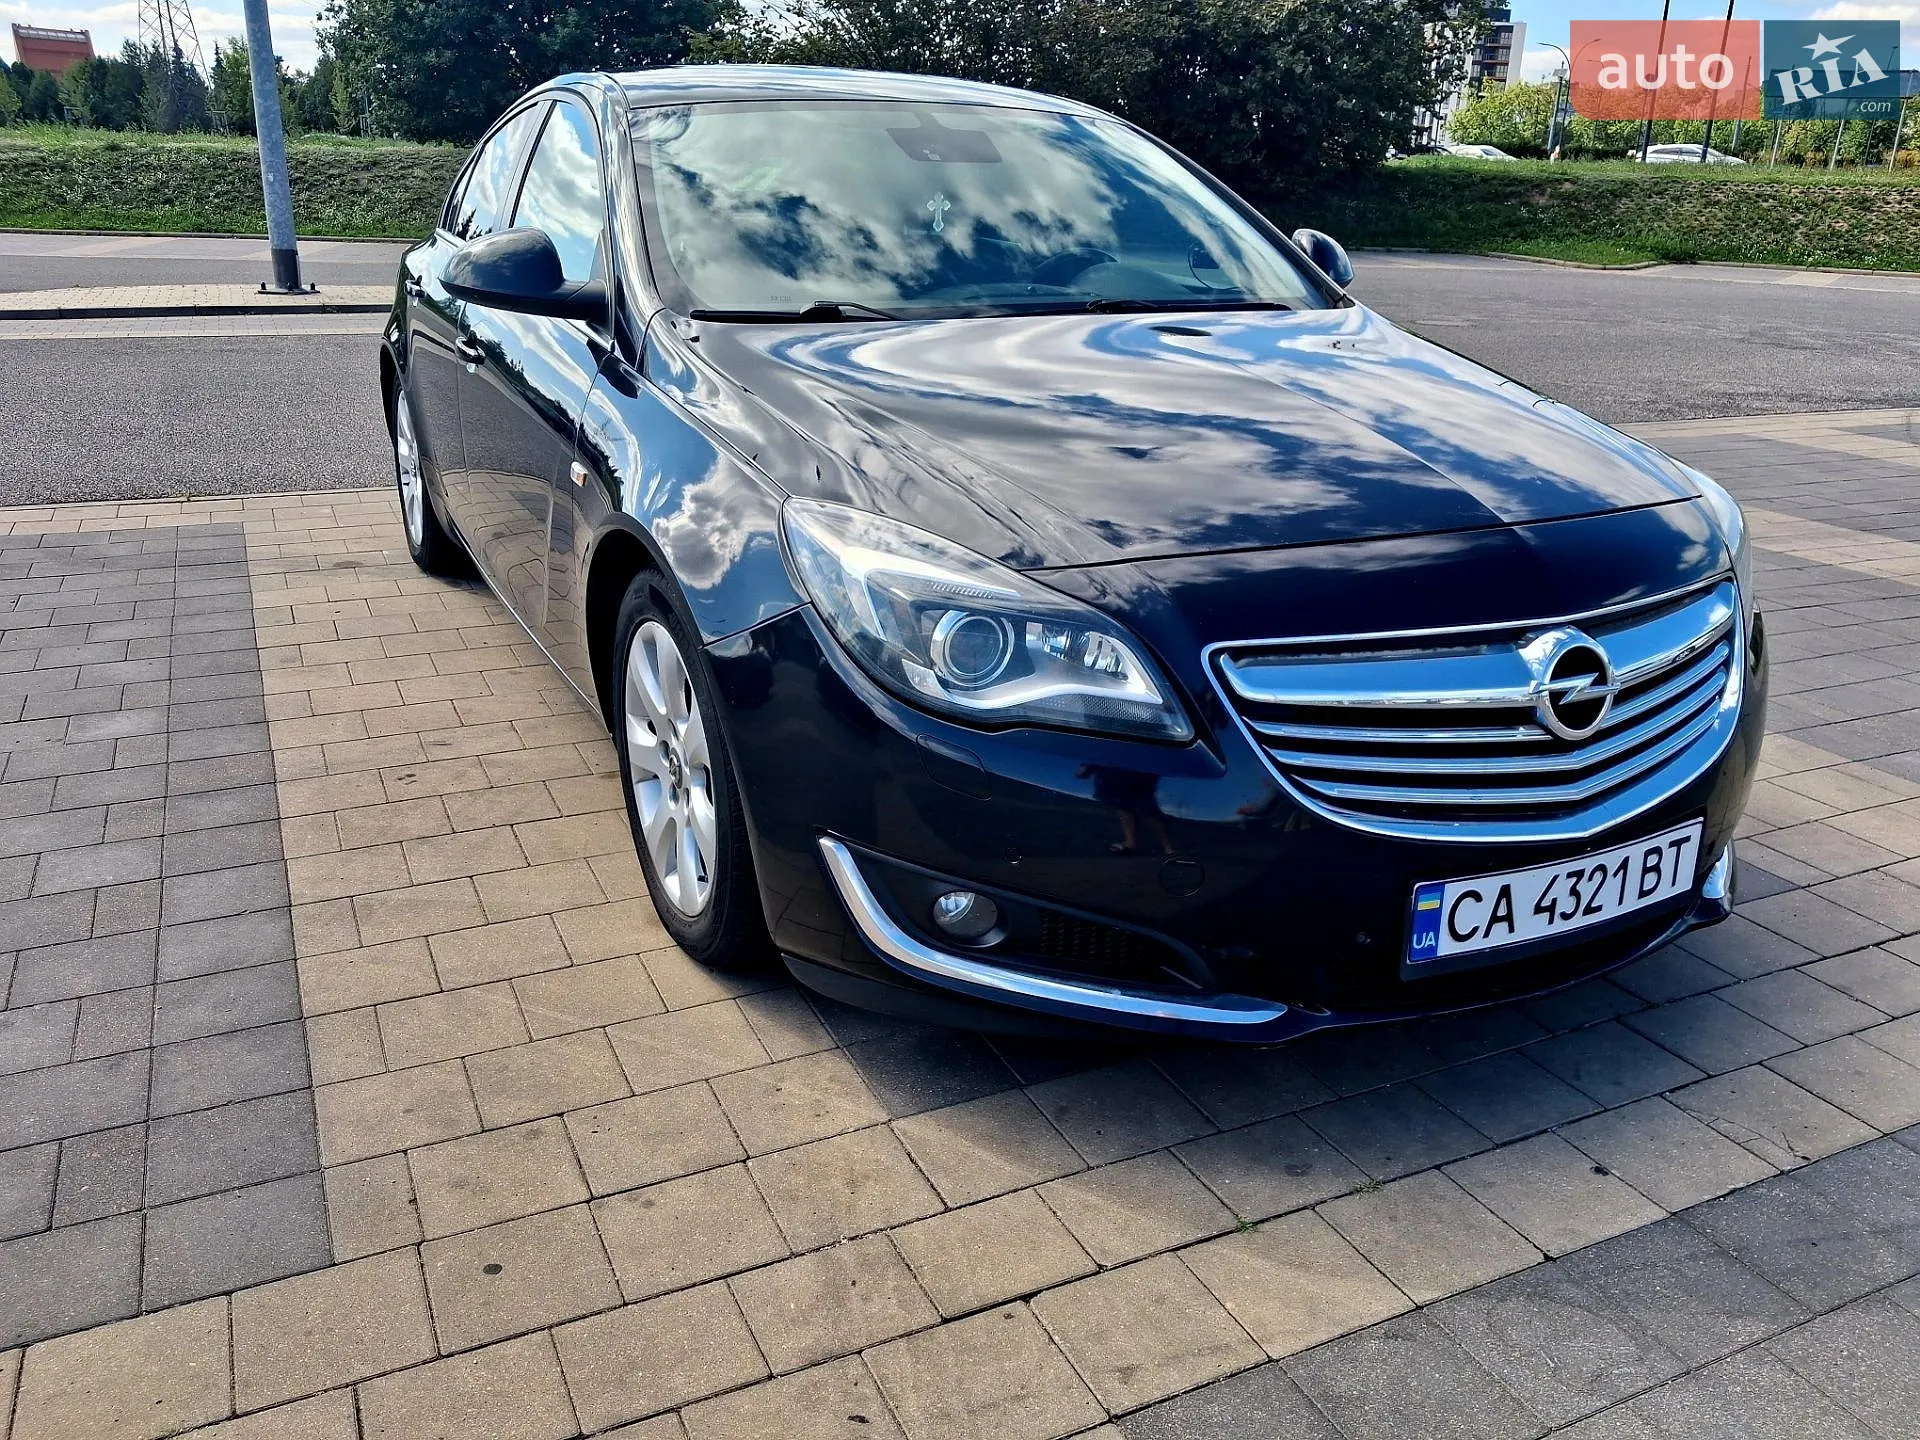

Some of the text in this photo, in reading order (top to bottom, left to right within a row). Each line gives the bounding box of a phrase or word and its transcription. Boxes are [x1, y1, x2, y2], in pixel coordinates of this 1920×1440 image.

[1447, 835, 1692, 943] CA 4321 BT
[1412, 931, 1436, 950] UA
